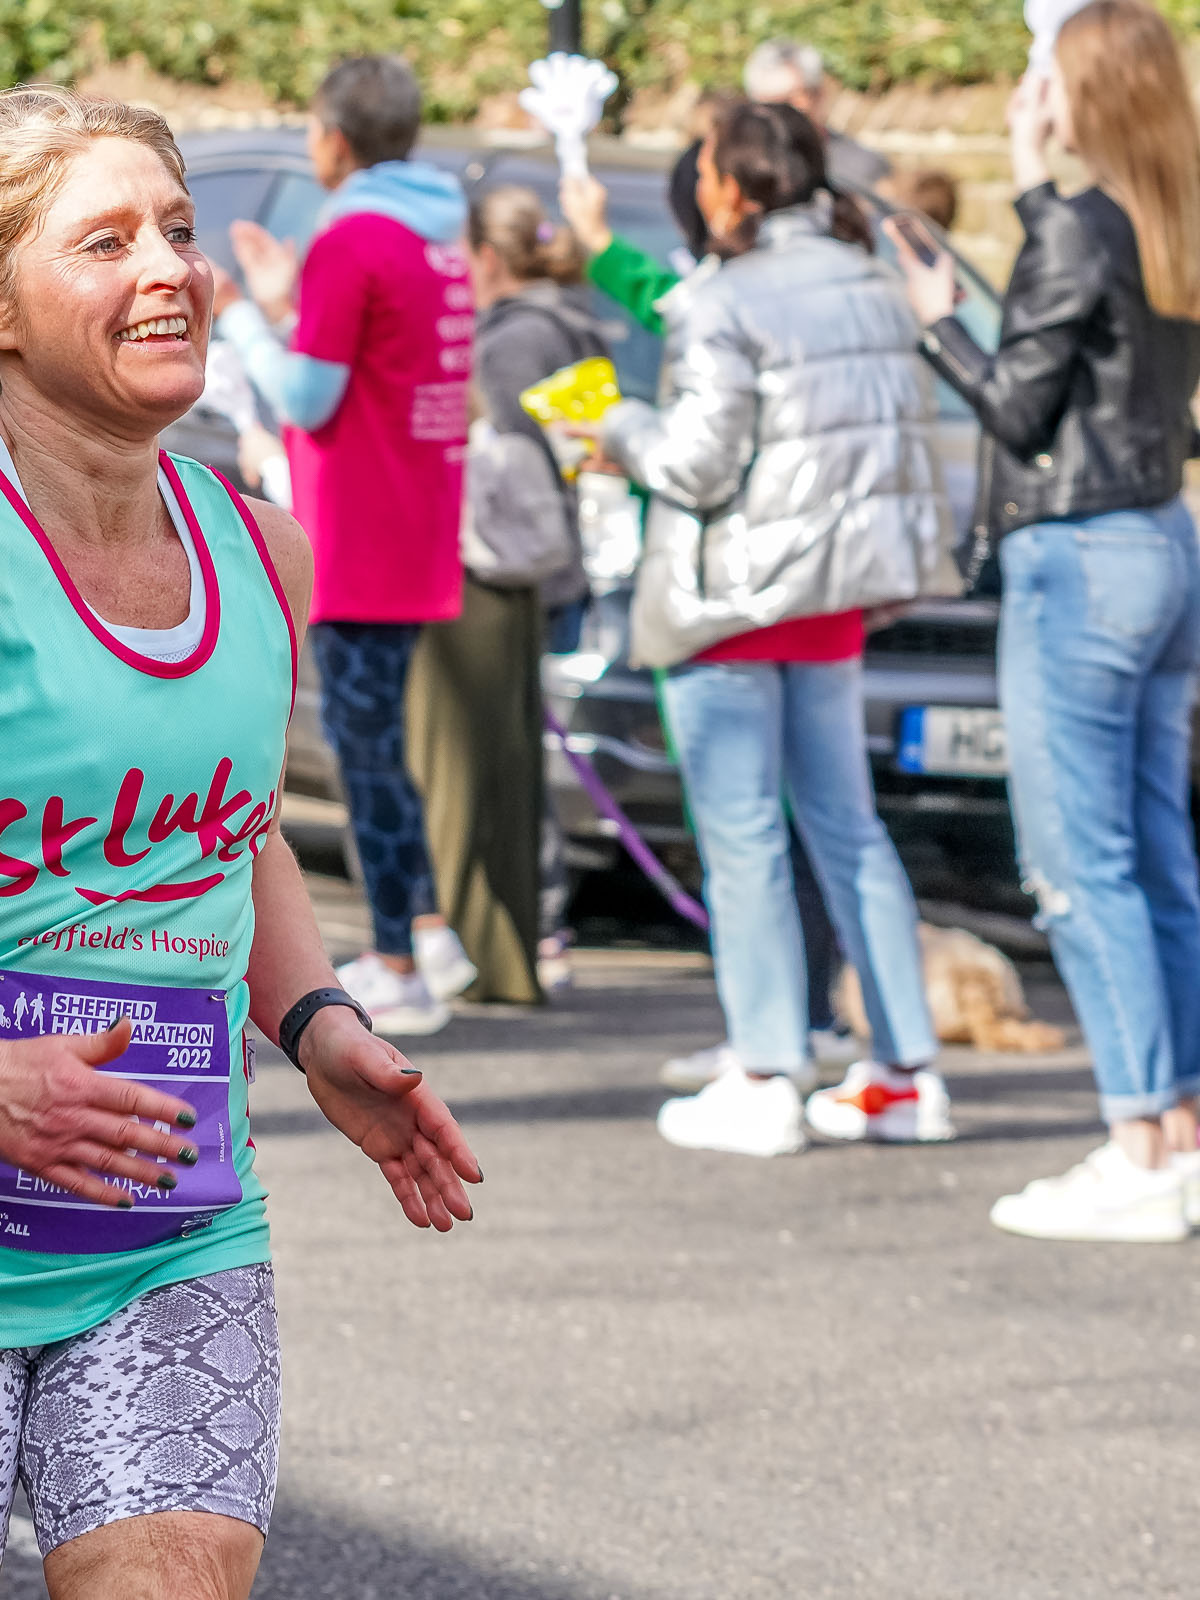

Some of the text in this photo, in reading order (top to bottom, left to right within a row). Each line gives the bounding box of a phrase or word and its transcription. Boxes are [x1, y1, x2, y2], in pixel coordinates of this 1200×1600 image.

[151, 930, 229, 962] Hospice
[54, 995, 154, 1020] SHEFFIELD
[131, 1024, 212, 1045] ARATHON
[166, 1048, 211, 1068] 2022
[4, 1222, 30, 1237] ALL
